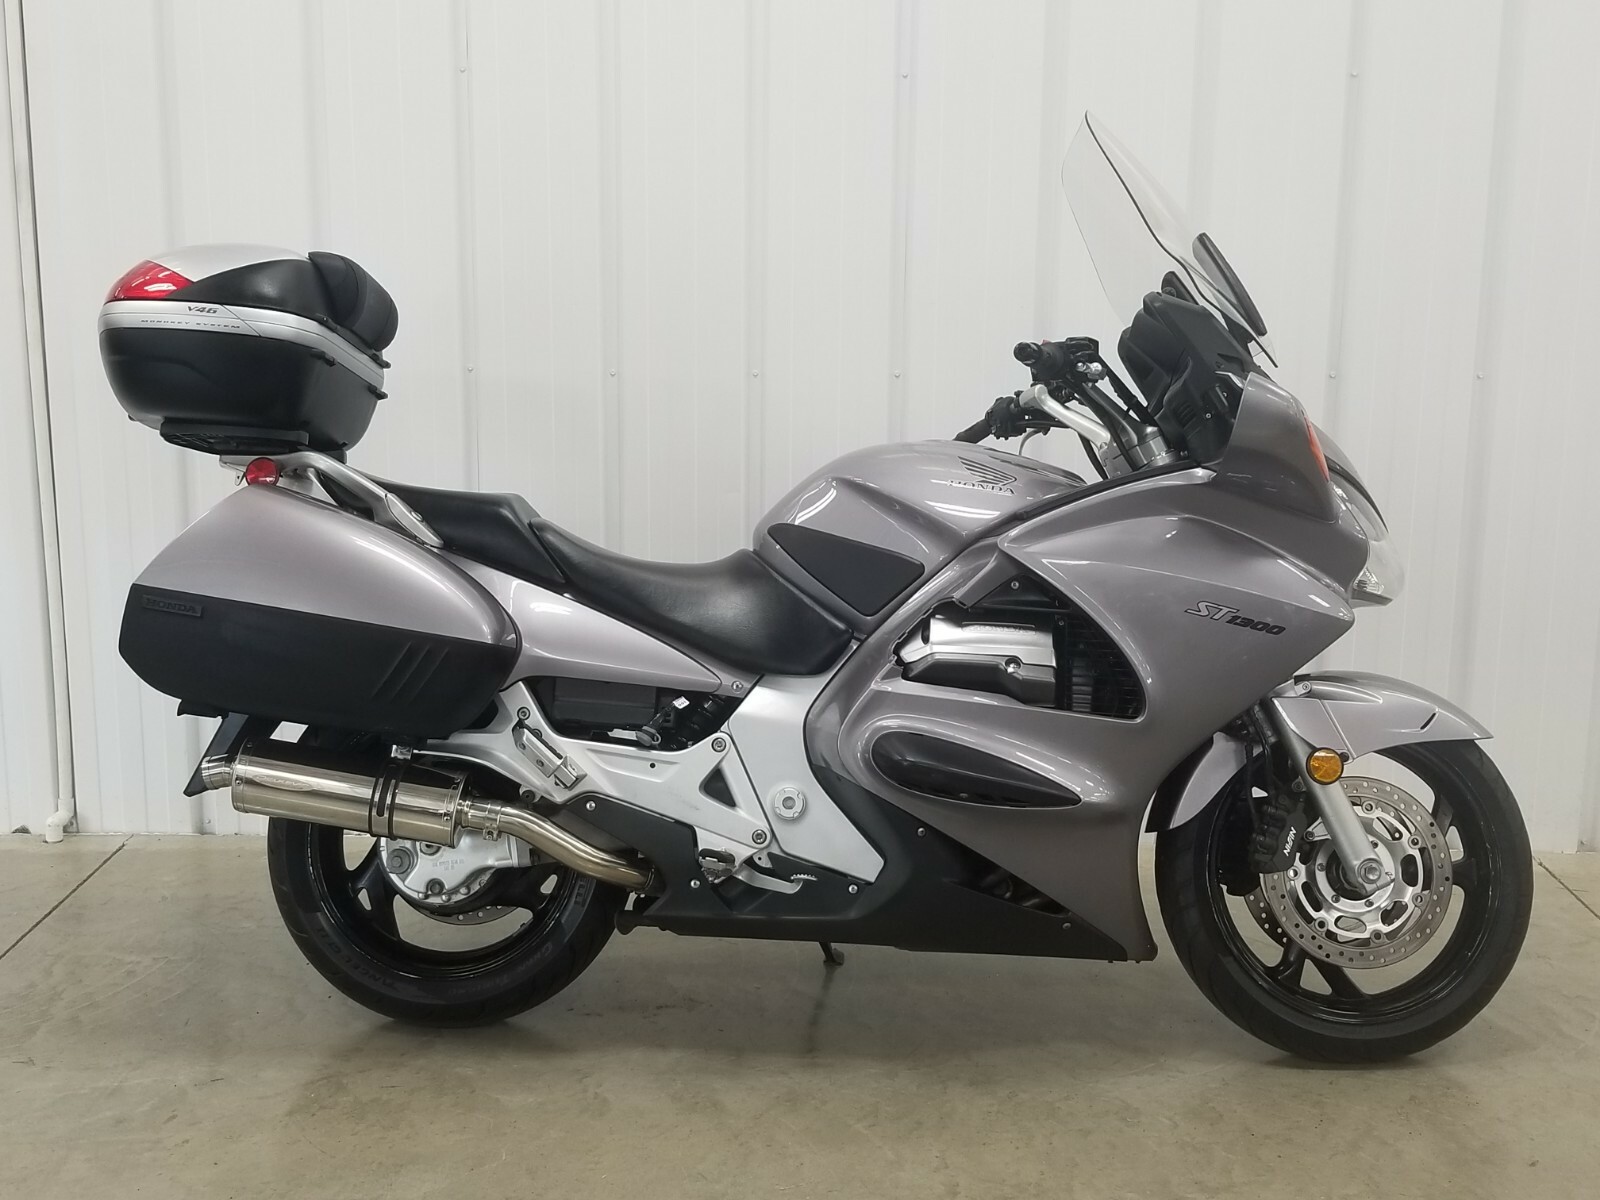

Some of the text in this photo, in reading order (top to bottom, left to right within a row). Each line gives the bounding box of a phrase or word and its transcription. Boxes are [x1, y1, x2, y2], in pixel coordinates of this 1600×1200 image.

[187, 305, 219, 314] V46
[196, 321, 240, 329] SYSTEM
[947, 480, 1016, 495] HONDA
[145, 598, 199, 614] HONDA
